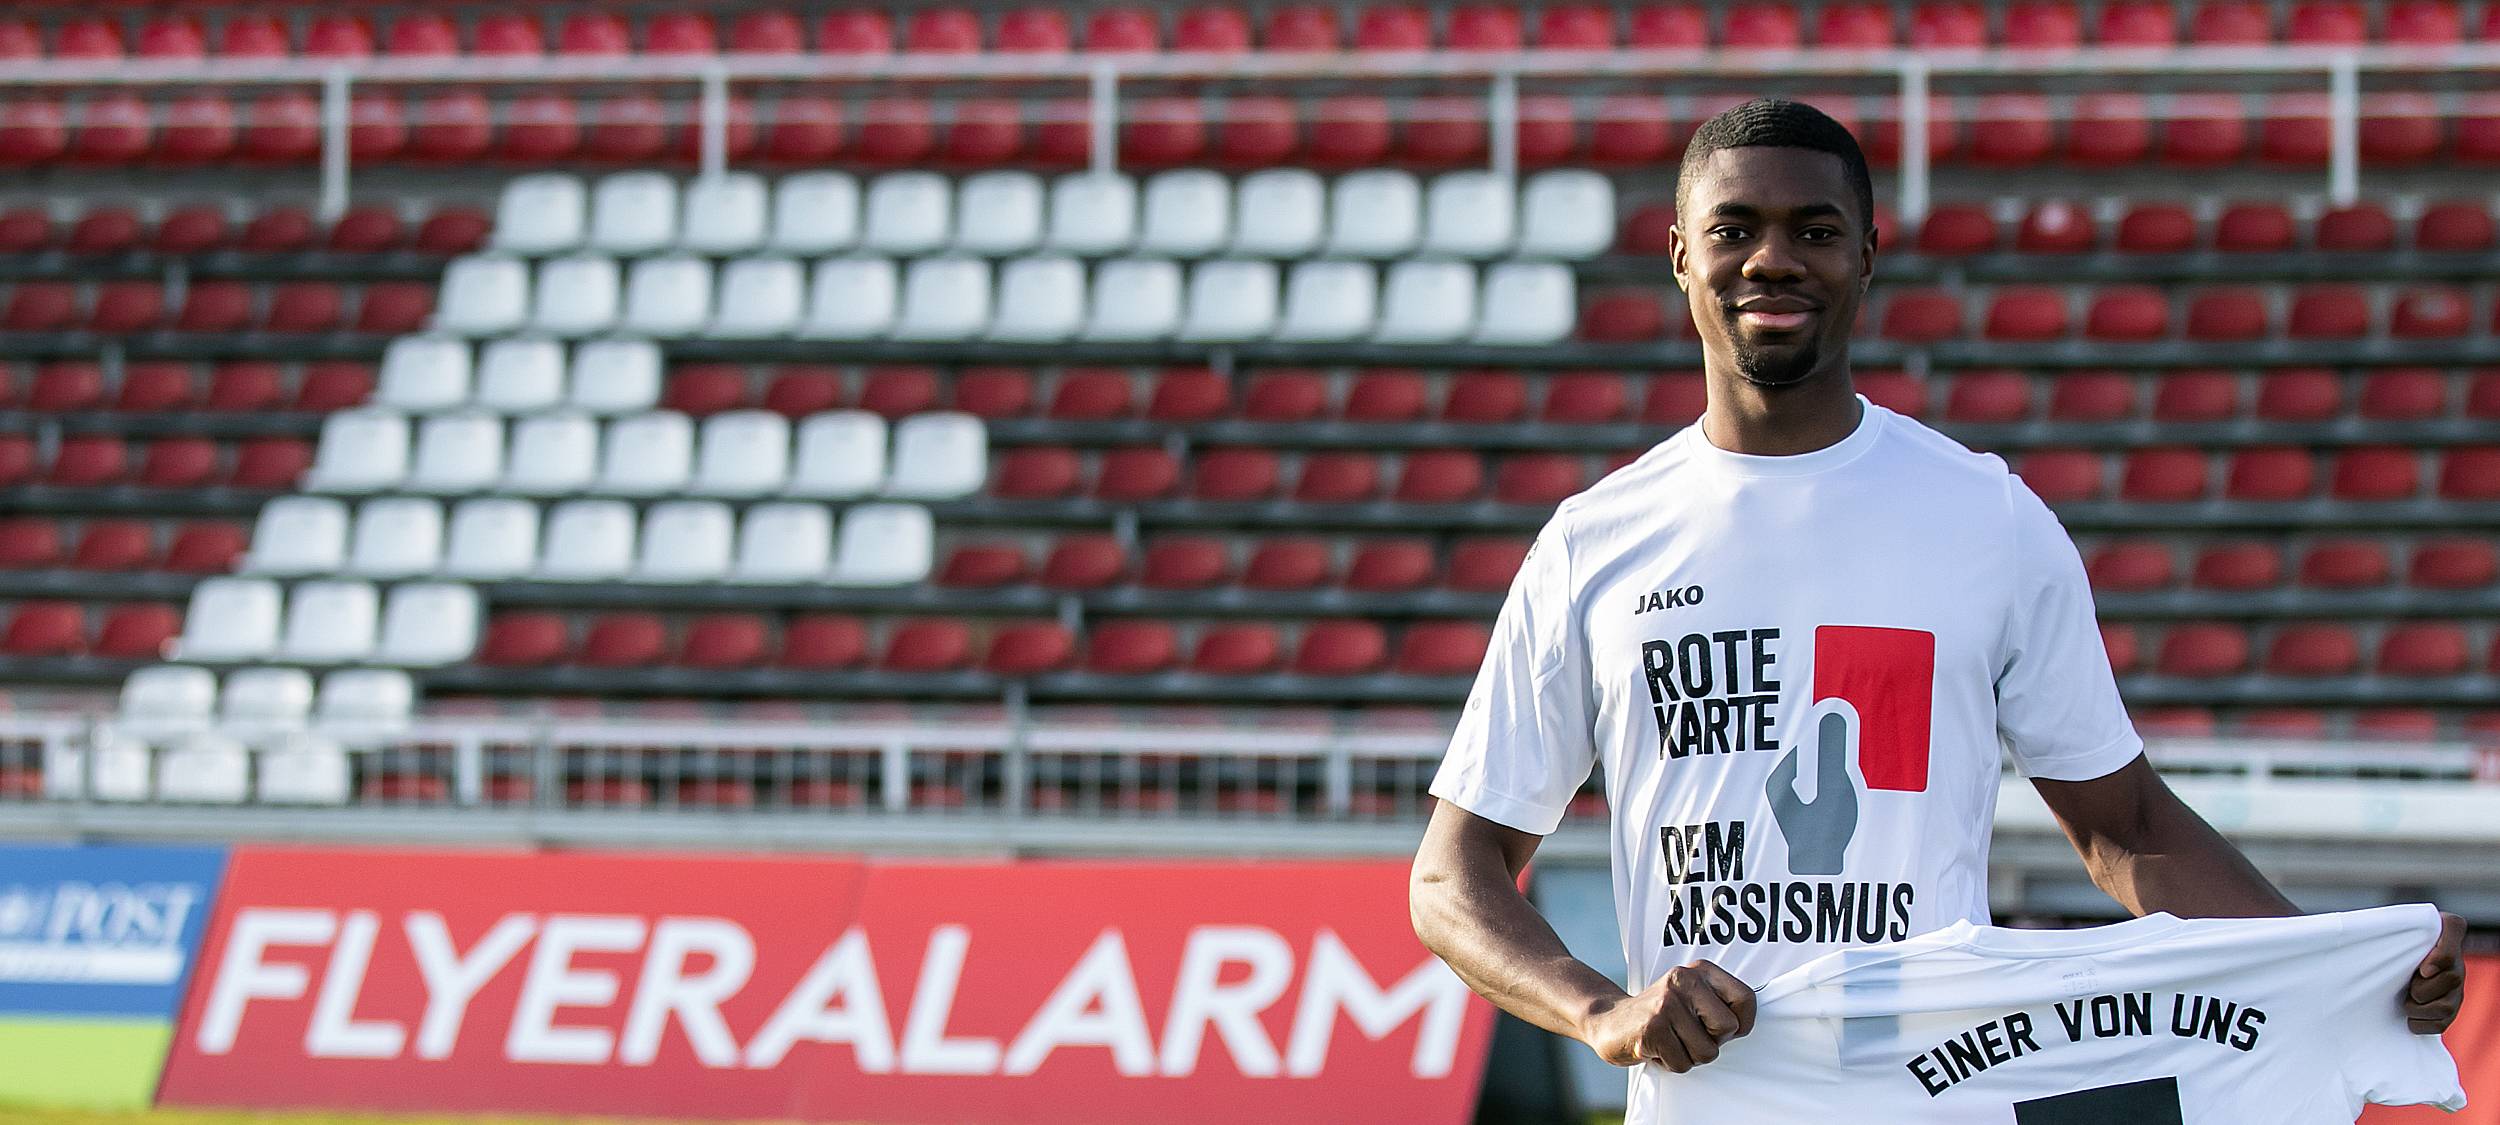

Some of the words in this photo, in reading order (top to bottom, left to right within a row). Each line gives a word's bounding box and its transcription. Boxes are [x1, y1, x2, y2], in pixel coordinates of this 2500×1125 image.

[1634, 584, 1705, 616] JAKO
[1641, 628, 1781, 704] ROTE
[1653, 694, 1780, 761] KARTE
[1660, 821, 1745, 885] DEM
[1663, 881, 1915, 947] RASSISMUS
[196, 907, 1472, 1079] FLYERALARM
[1905, 1011, 2043, 1098] EINER
[2053, 992, 2153, 1043] VON
[2170, 992, 2268, 1053] UNS
